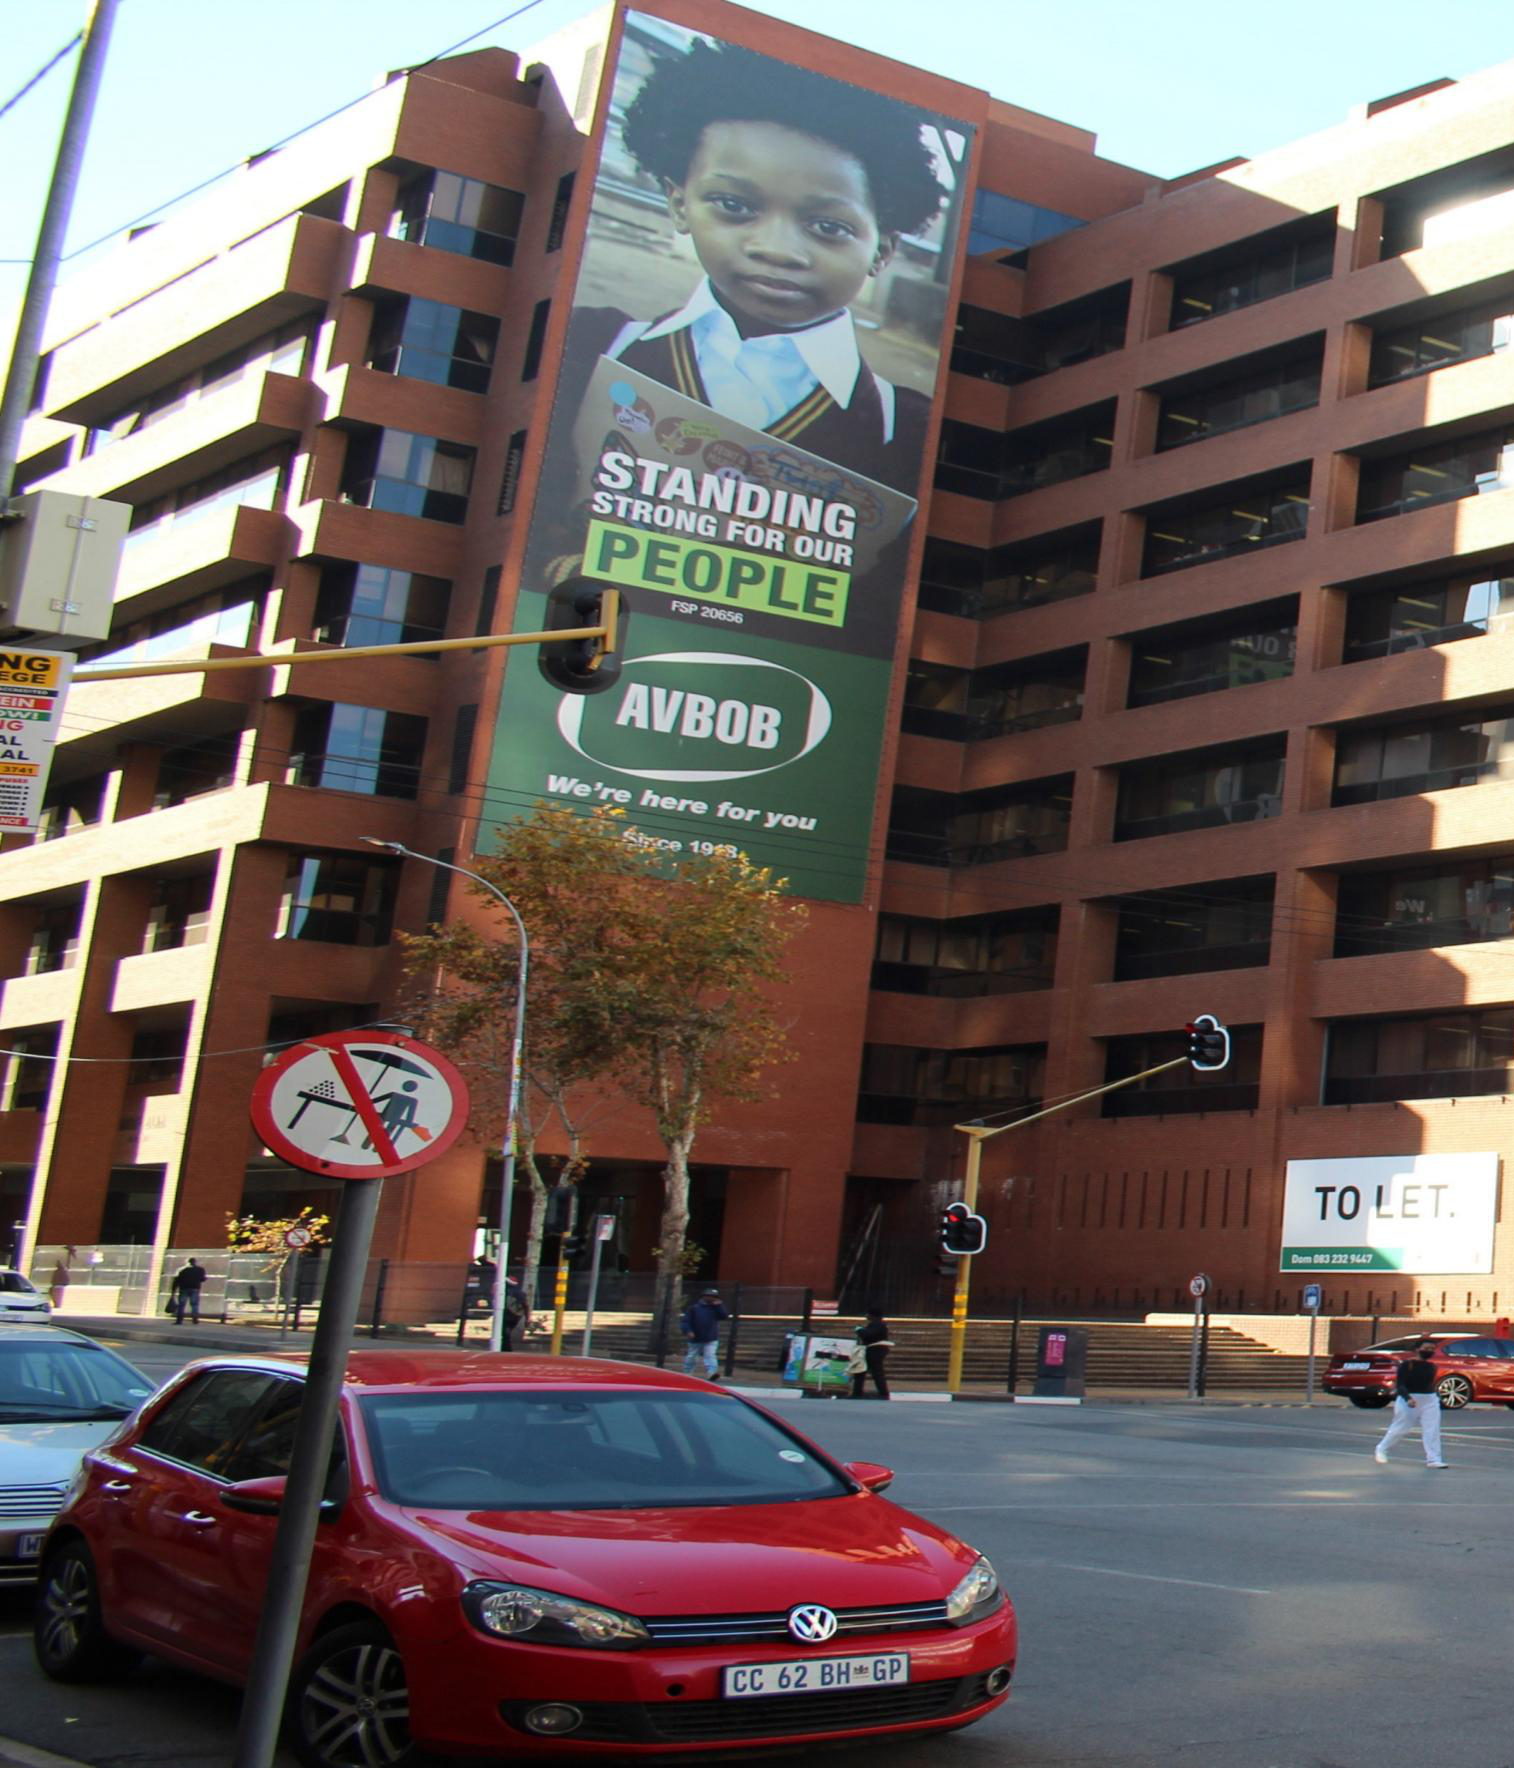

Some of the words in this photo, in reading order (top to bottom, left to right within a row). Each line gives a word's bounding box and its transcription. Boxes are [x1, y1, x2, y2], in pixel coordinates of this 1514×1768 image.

[599, 450, 857, 541] STANDING
[591, 490, 718, 538] STRONG
[725, 519, 787, 553] FOR
[793, 535, 854, 567] OUR
[596, 528, 839, 619] PEOPLE
[670, 599, 699, 615] FSP
[701, 605, 745, 625] 20656
[615, 682, 783, 750] AVBOB
[547, 774, 632, 804] We're
[640, 789, 709, 815] here
[716, 801, 761, 823] for
[764, 811, 818, 833] you
[1314, 1184, 1361, 1221] TO
[1375, 1184, 1455, 1220] LET.
[1291, 1254, 1312, 1265] Dom
[1313, 1254, 1331, 1265] 083
[1331, 1254, 1349, 1265] 232
[1349, 1253, 1373, 1264] 9447
[733, 1668, 764, 1694] CC
[777, 1664, 808, 1689] 62
[820, 1661, 850, 1687] BH
[872, 1658, 902, 1682] GP
